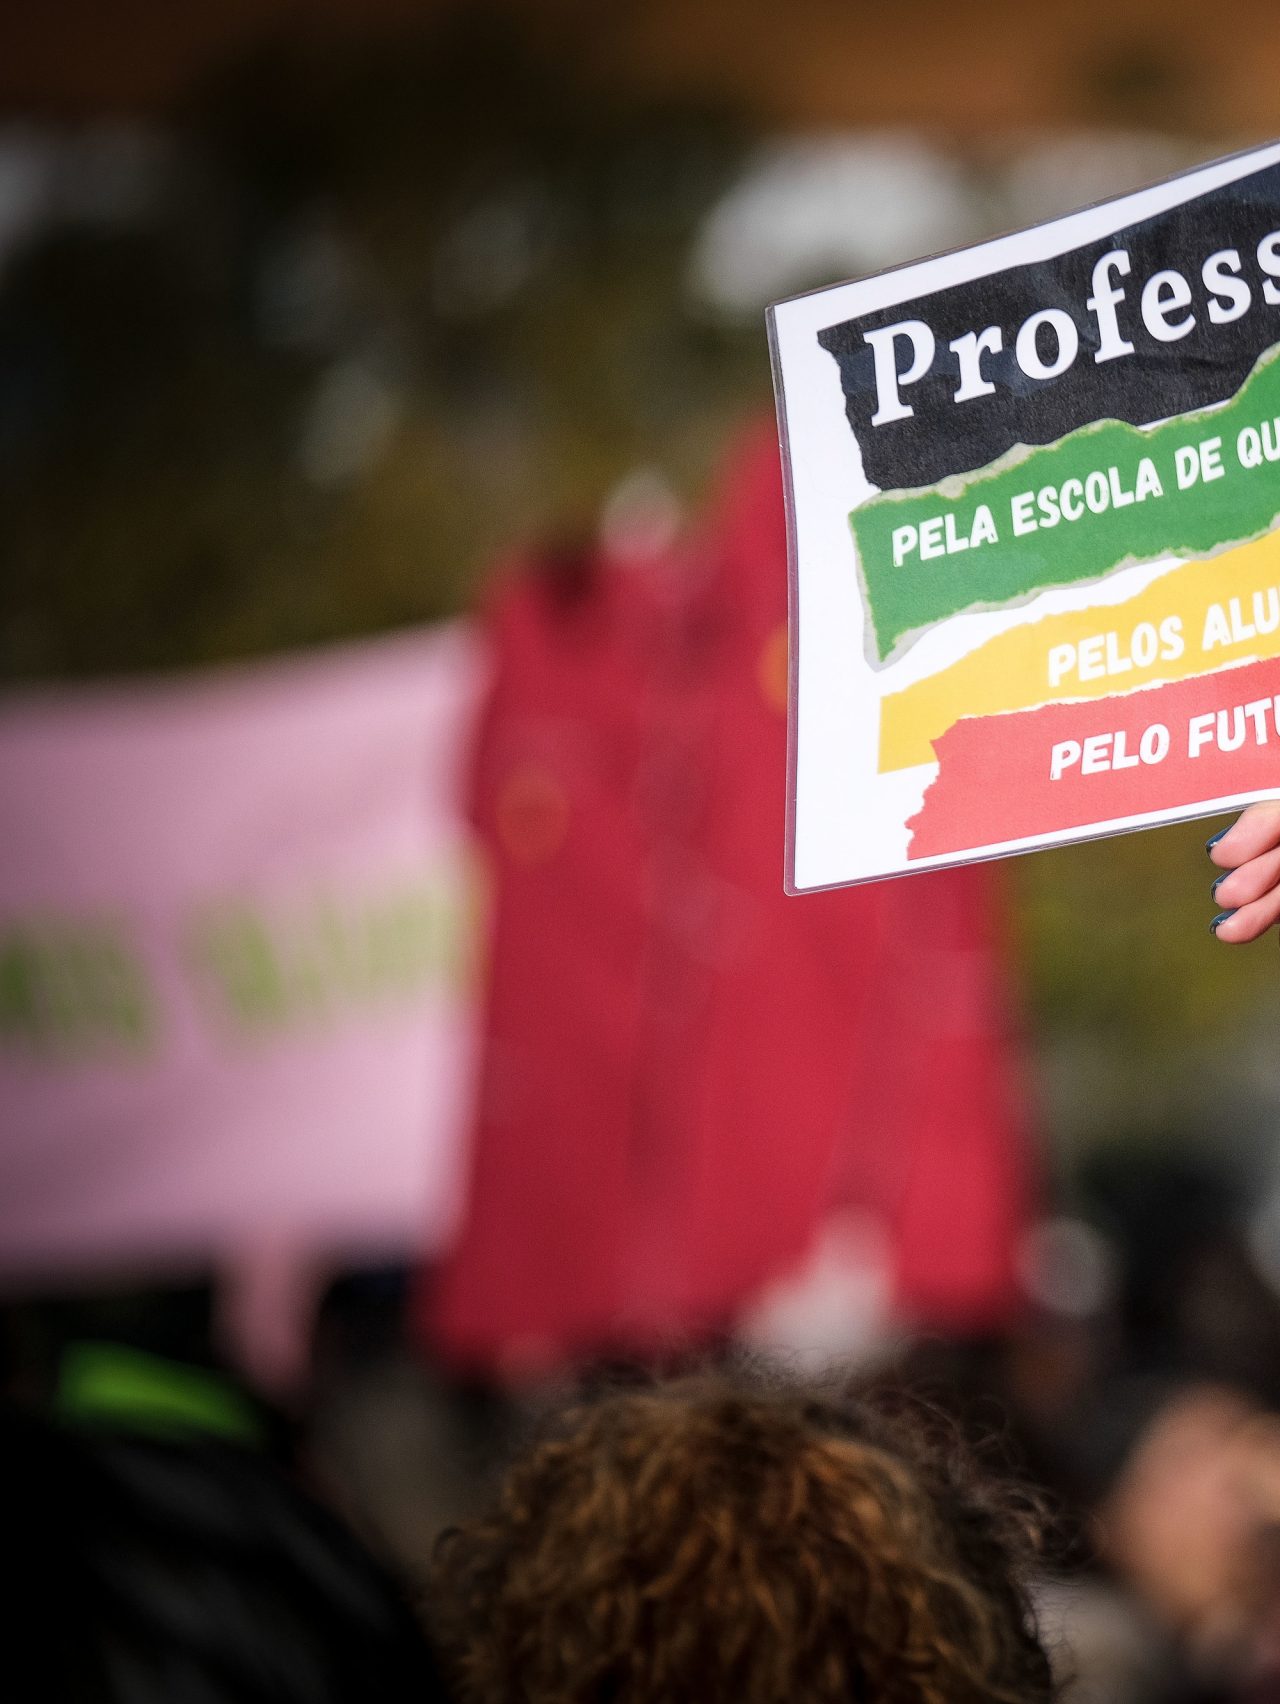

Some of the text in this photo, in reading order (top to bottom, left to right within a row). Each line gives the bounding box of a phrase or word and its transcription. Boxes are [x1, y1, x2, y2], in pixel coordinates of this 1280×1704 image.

[892, 505, 998, 567] PELA
[1010, 458, 1163, 536] ESCOLA
[1174, 436, 1226, 491] DE
[1048, 615, 1185, 687] PELOS
[1050, 723, 1169, 781] PELO
